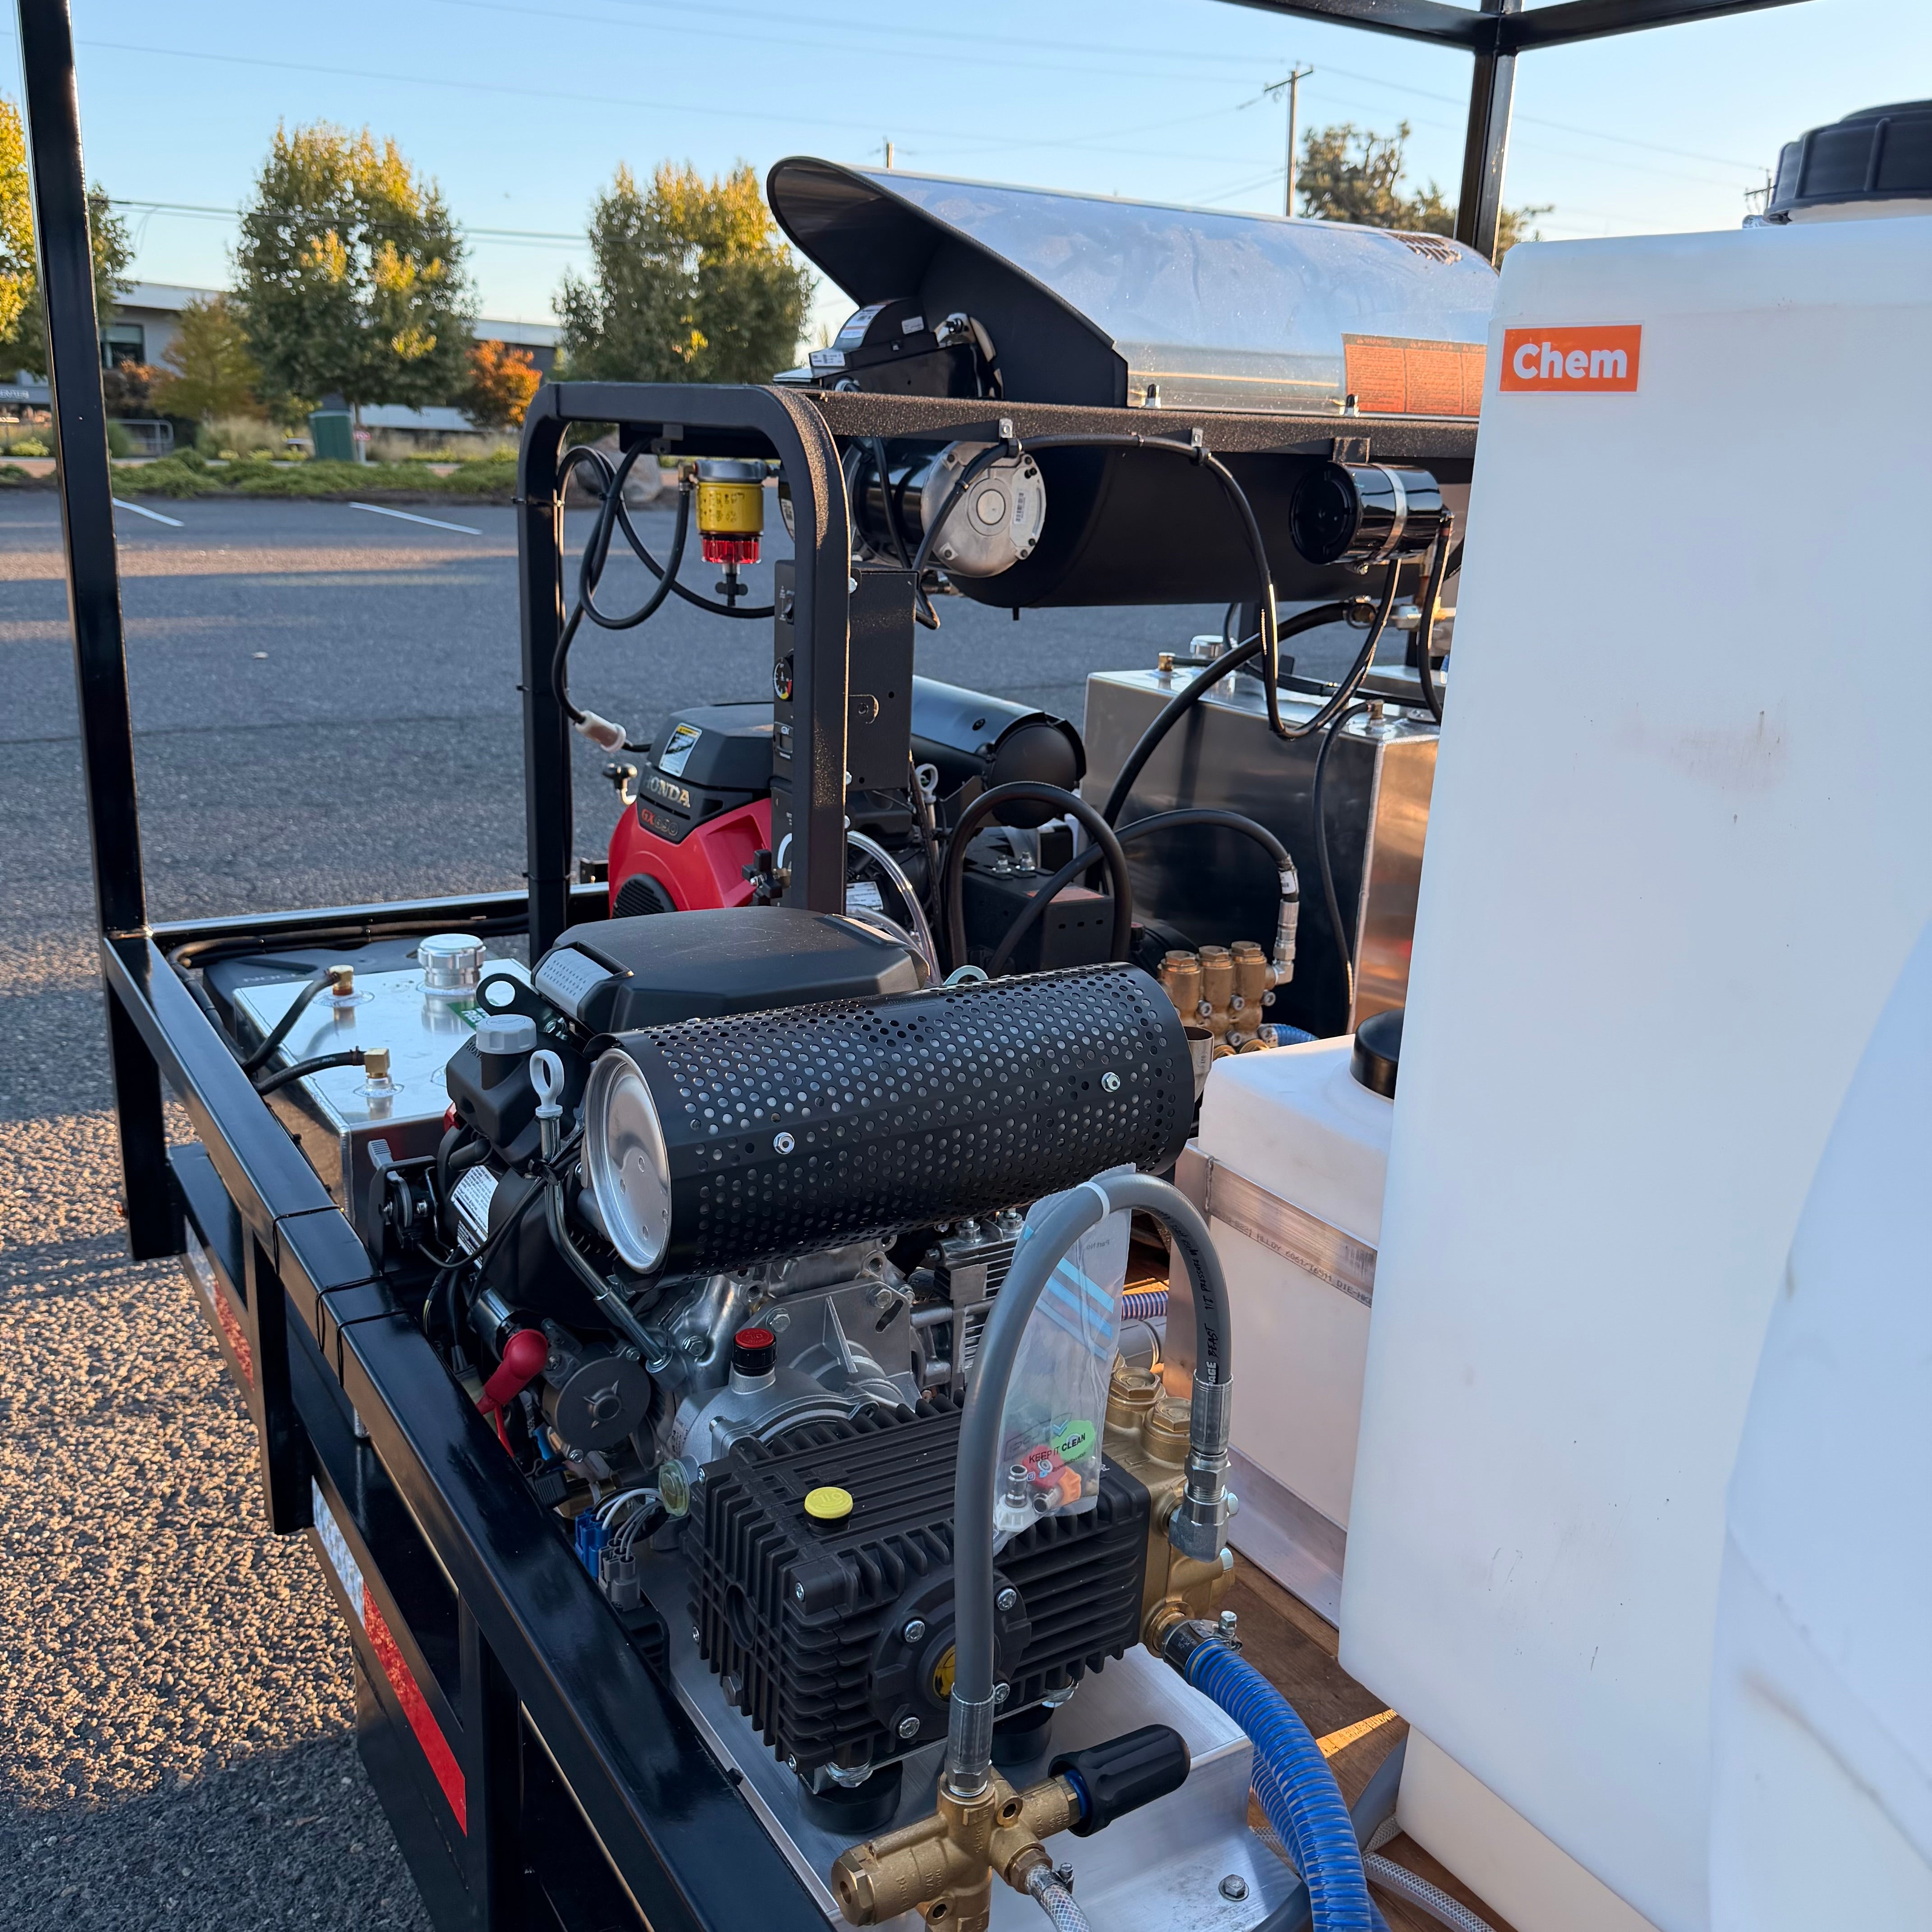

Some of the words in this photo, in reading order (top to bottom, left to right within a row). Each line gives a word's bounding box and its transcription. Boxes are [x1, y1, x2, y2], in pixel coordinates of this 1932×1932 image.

[1513, 342, 1627, 379] Chem
[644, 775, 690, 808] HONDA
[466, 1041, 482, 1060] HON
[1192, 1259, 1211, 1293] PRESSURE
[1204, 1323, 1219, 1358] BEAST
[1029, 1450, 1052, 1464] KEEP
[1053, 1446, 1060, 1456] IT
[1062, 1433, 1086, 1452] CLEAN
